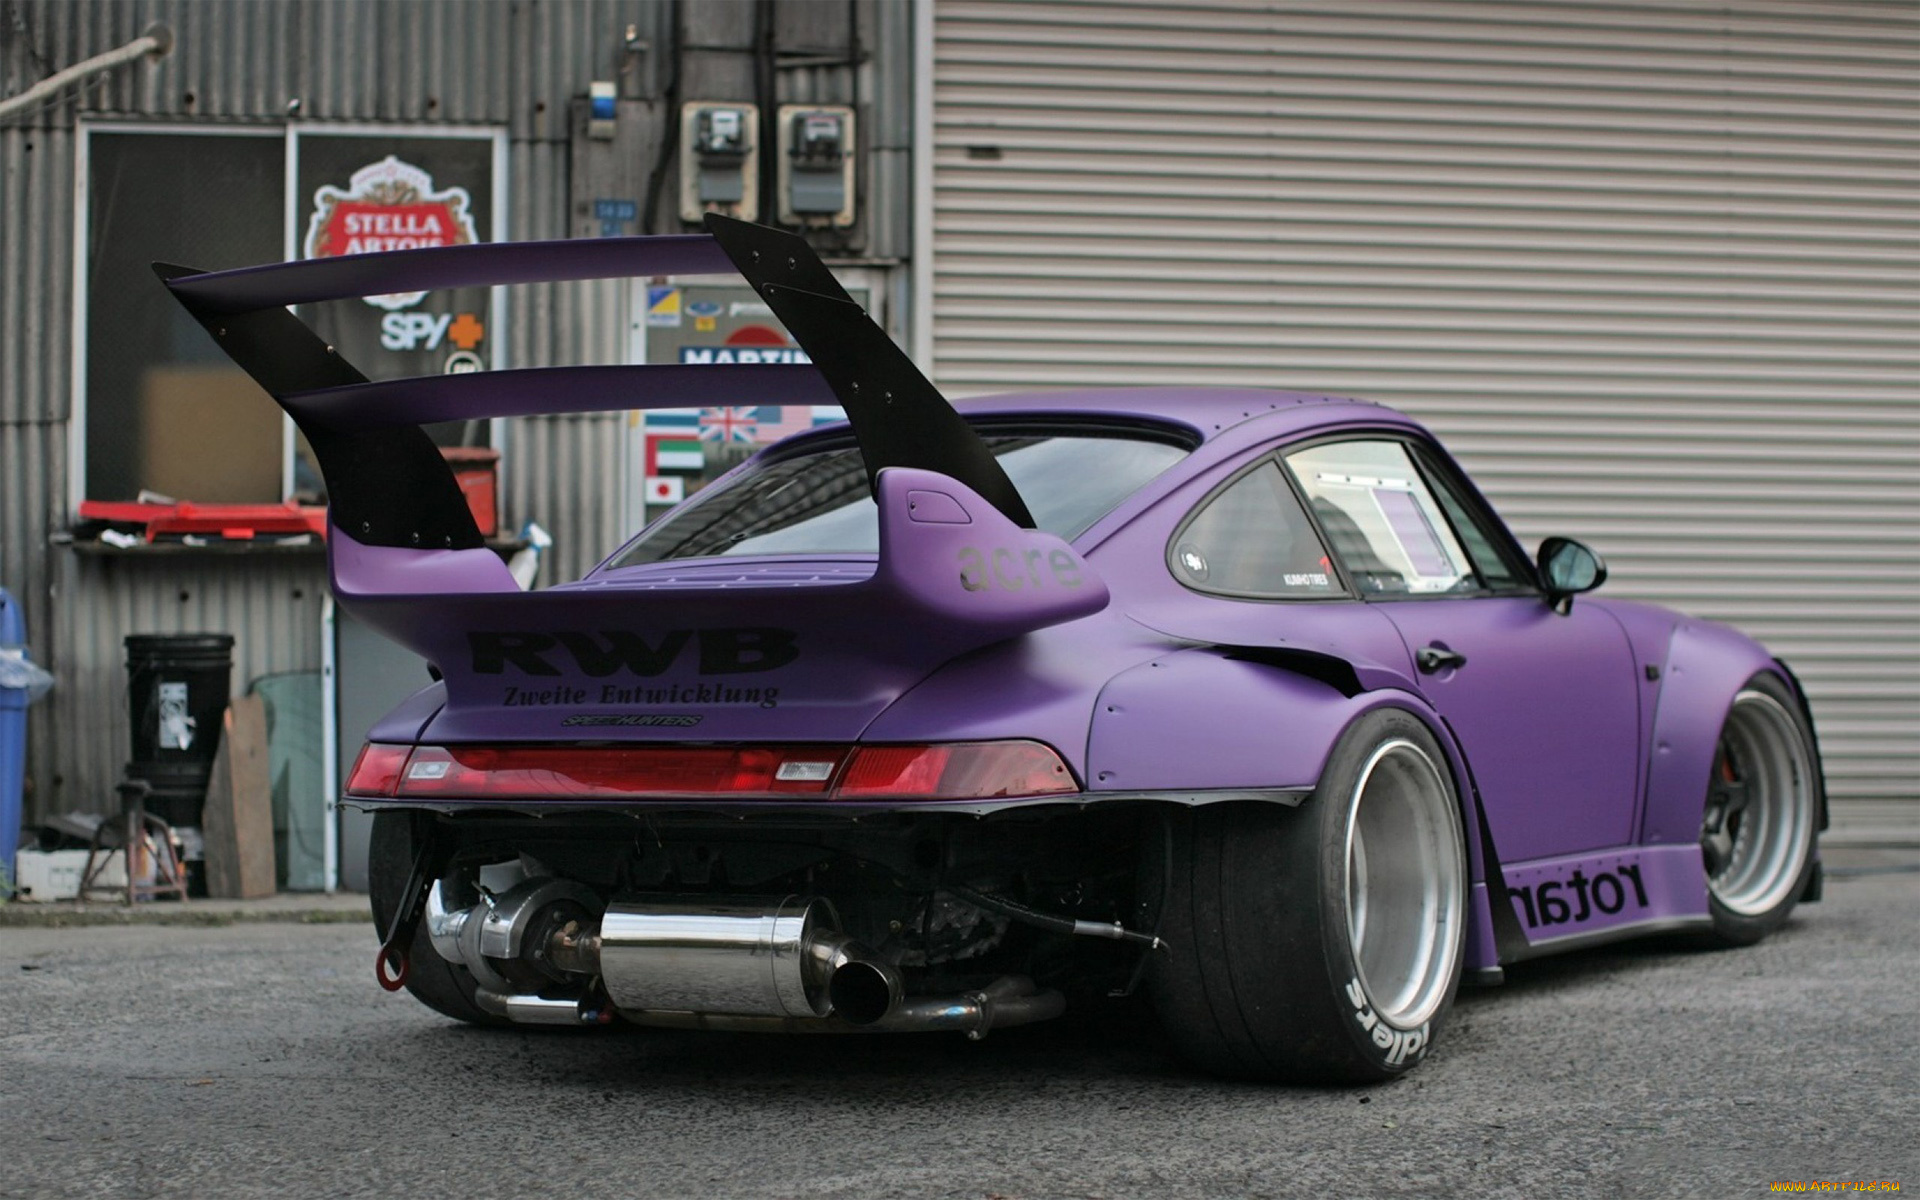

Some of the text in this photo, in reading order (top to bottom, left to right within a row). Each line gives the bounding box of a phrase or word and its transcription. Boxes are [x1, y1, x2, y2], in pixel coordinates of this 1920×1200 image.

[344, 212, 442, 235] STELLA
[381, 312, 450, 350] SPY
[957, 546, 1084, 592] acre
[467, 626, 800, 677] RWB
[503, 683, 780, 709] Zweite Entwicklung
